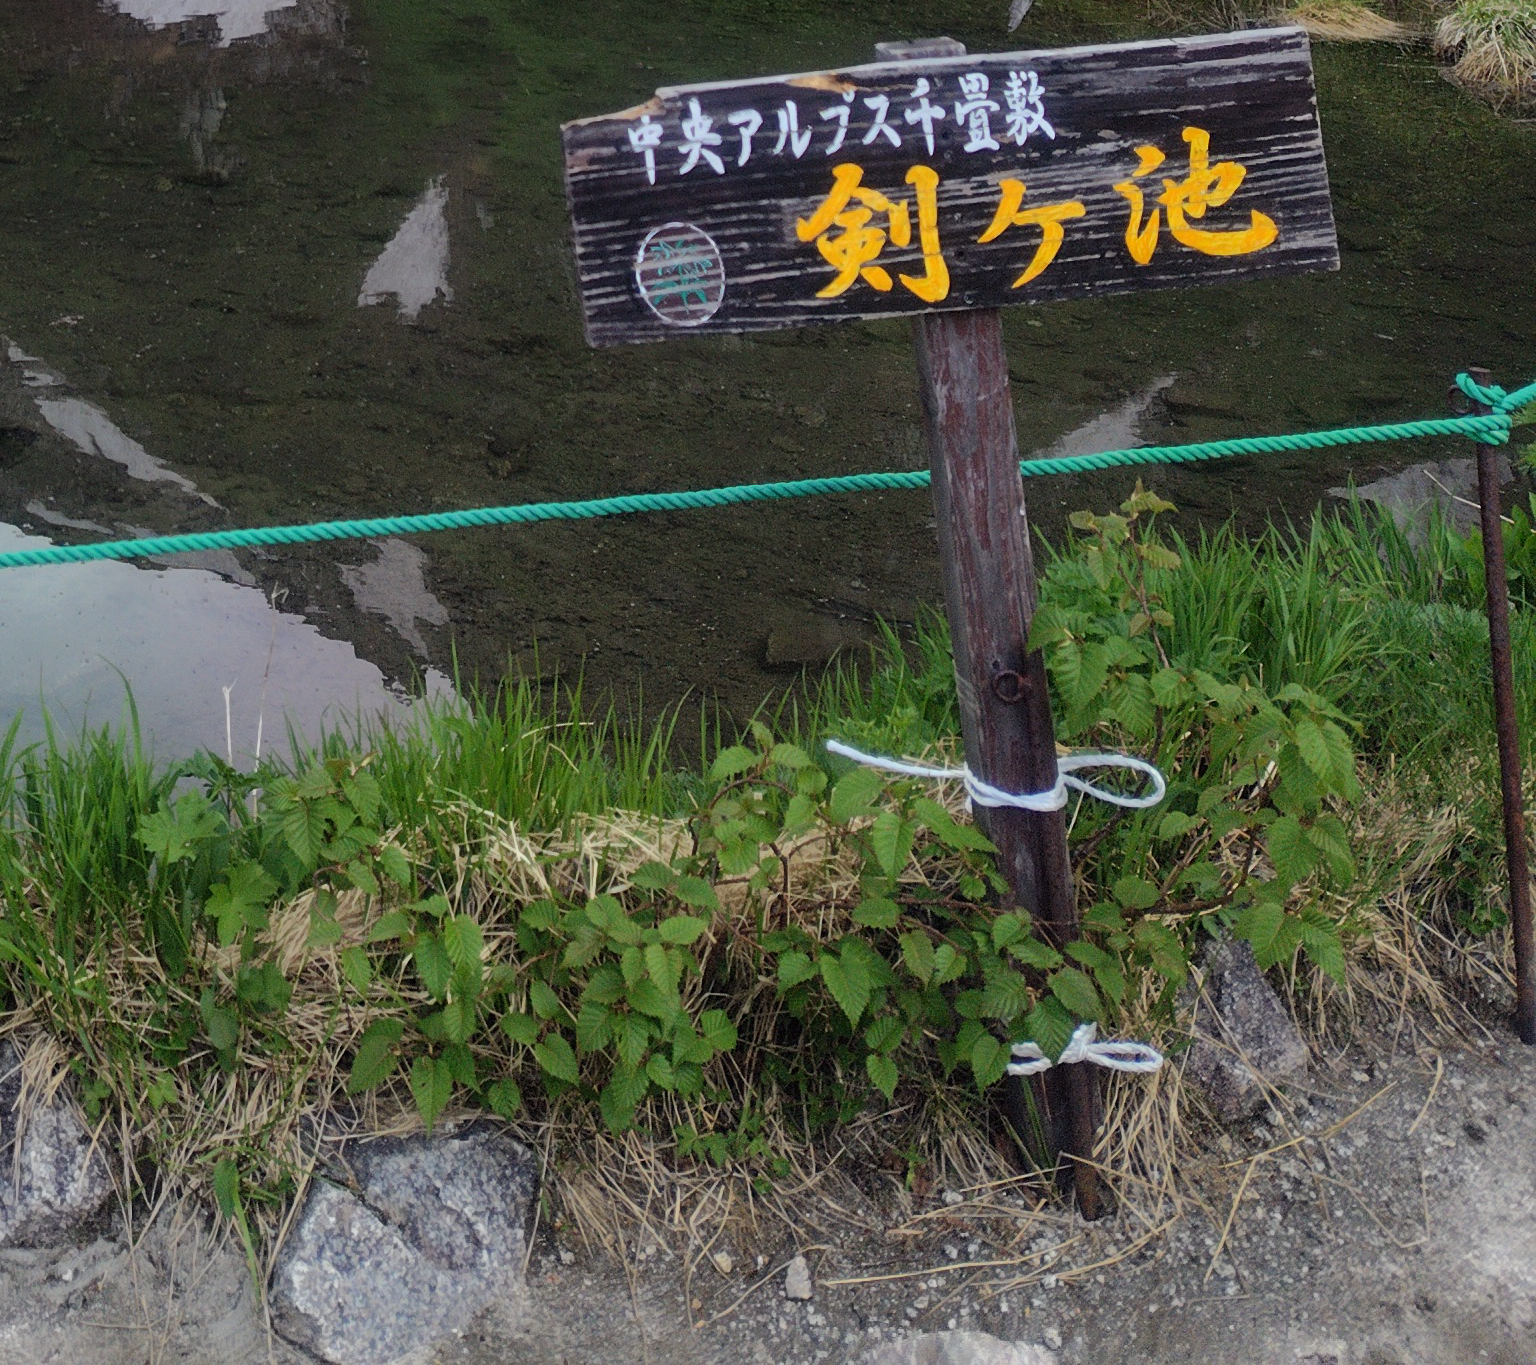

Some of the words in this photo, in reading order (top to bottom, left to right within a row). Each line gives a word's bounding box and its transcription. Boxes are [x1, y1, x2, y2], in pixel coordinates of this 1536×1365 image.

[627, 70, 1057, 185] 中央アルプス千畳敷
